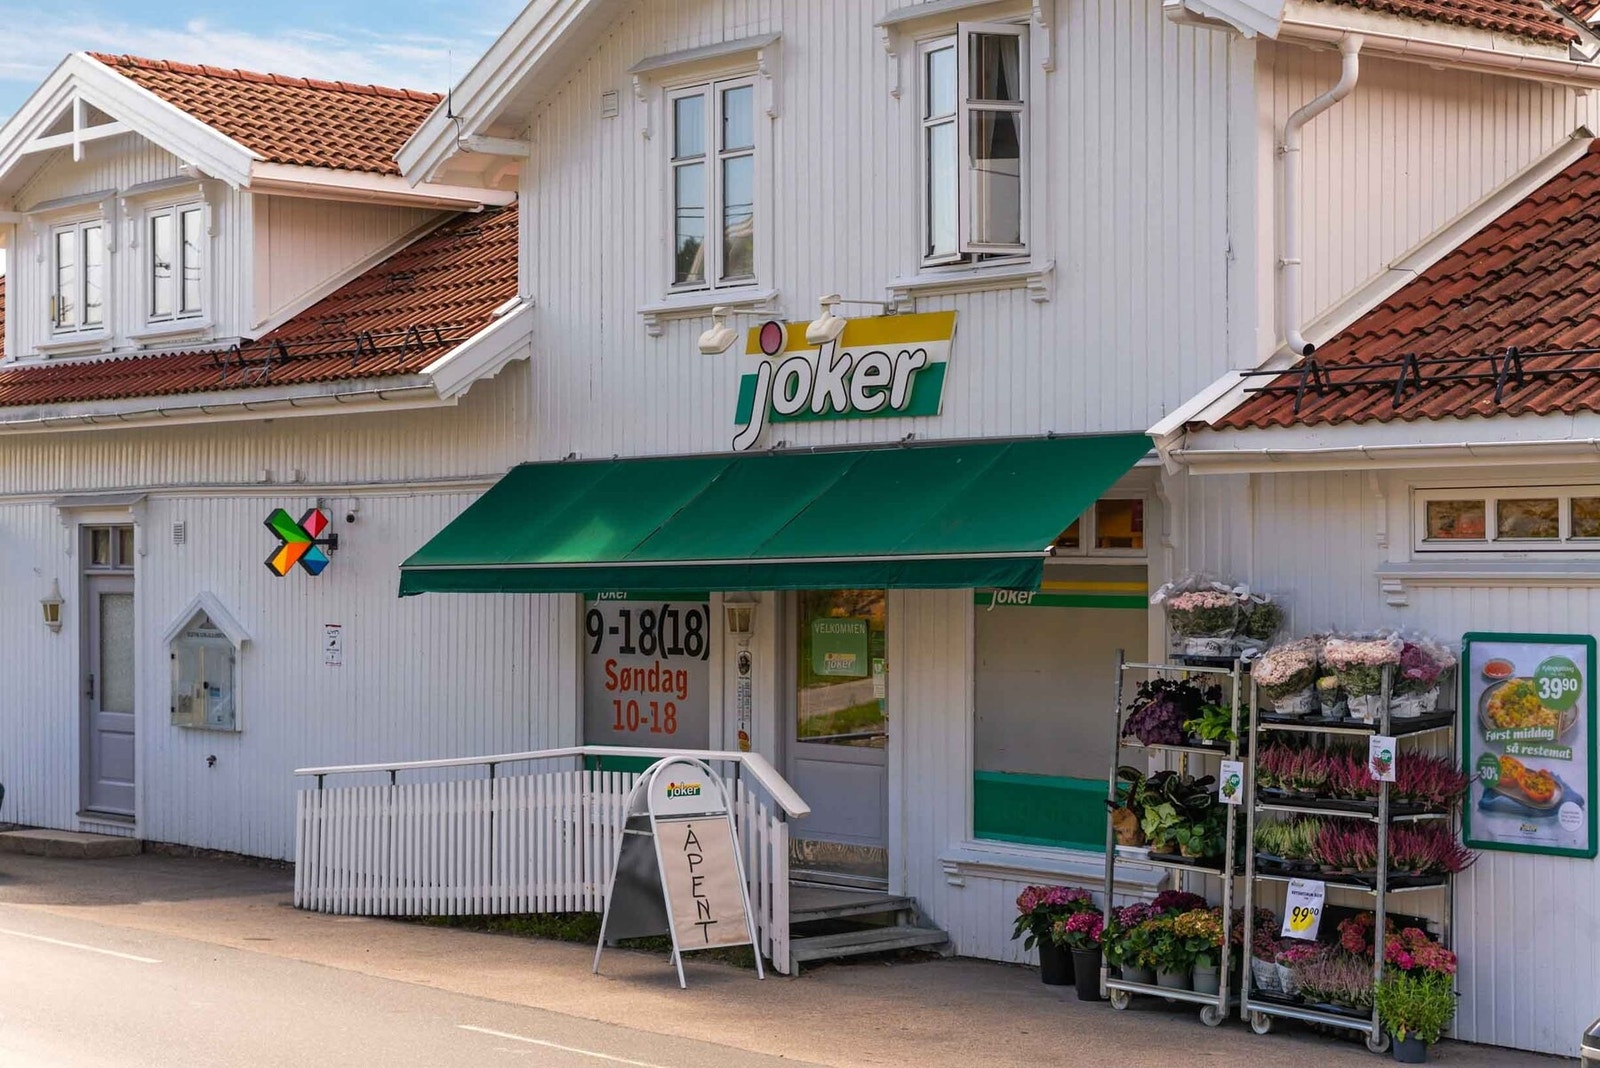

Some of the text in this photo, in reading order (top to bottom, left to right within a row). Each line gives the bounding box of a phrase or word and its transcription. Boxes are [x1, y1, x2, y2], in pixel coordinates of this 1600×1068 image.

[732, 320, 928, 451] joker
[814, 622, 866, 634] VELKOMMEN
[604, 658, 688, 700] Søndag
[612, 700, 677, 735] 10-18
[1485, 727, 1554, 741] Først middag
[1506, 742, 1571, 759] så restemat
[668, 782, 700, 800] joker
